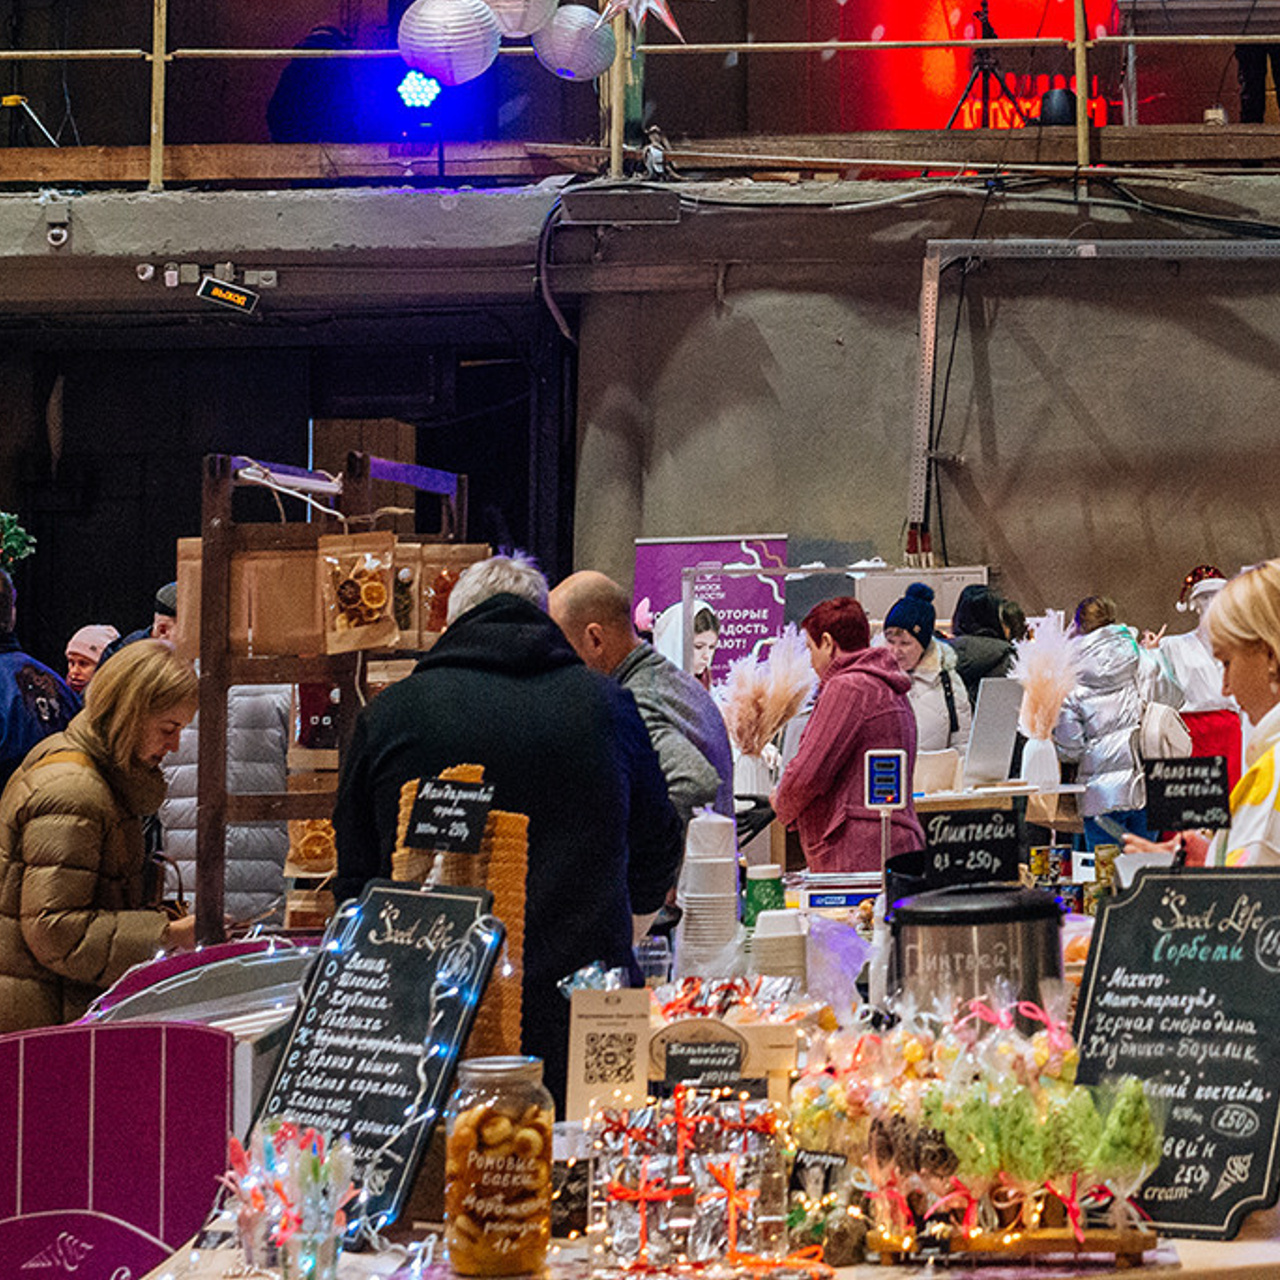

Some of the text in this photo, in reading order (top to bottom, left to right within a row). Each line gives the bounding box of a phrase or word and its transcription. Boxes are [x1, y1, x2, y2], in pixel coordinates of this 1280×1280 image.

[719, 623, 769, 636] АДОСТЬ
[928, 812, 1015, 846] Глинтвейн
[965, 849, 1002, 874] 250р
[1217, 1108, 1255, 1136] 250р
[1162, 1133, 1217, 1159] вейн
